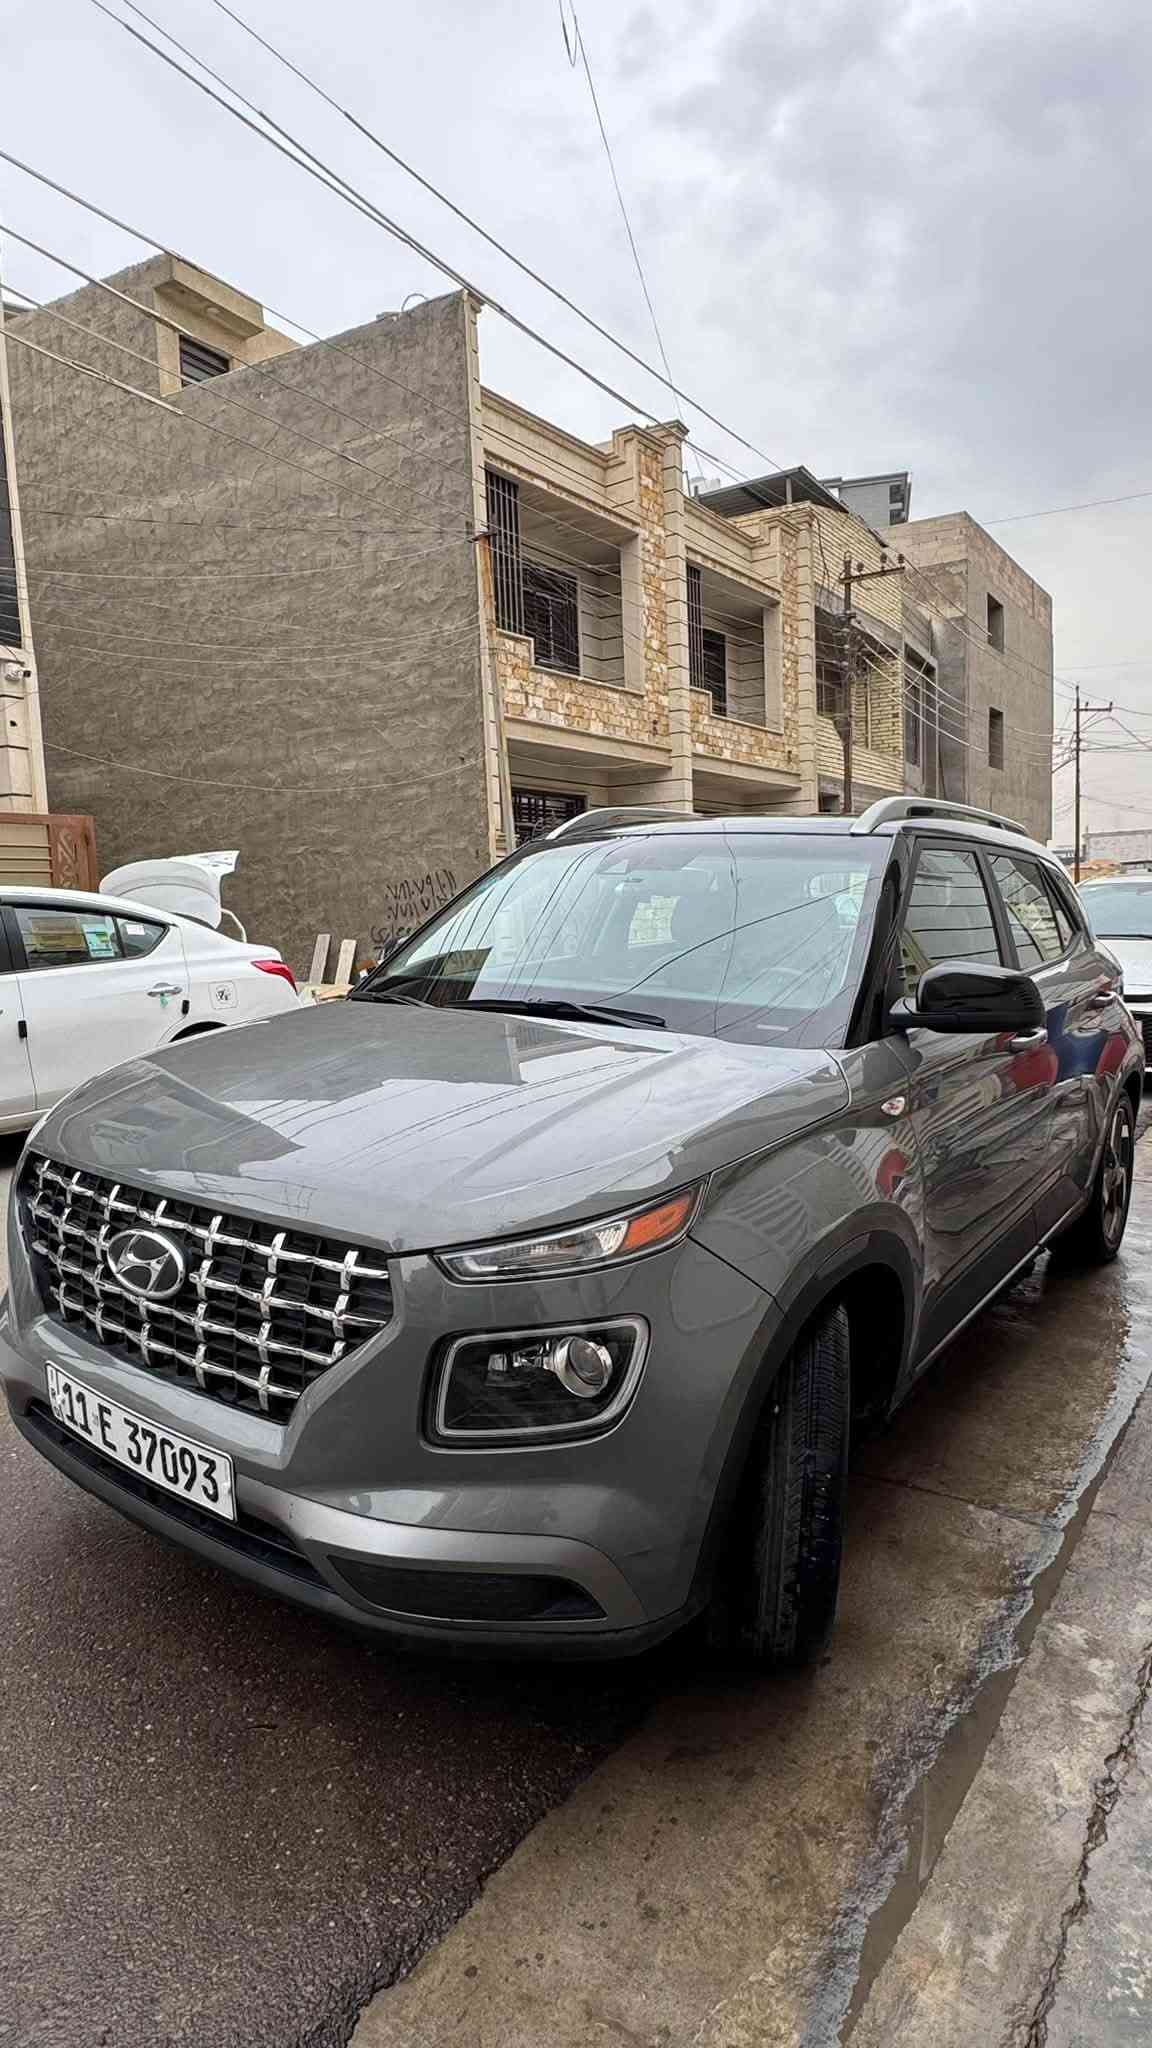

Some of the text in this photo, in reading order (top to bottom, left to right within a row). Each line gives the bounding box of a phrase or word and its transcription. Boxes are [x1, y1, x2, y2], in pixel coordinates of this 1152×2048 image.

[63, 1382, 219, 1503] 11 E 37093
